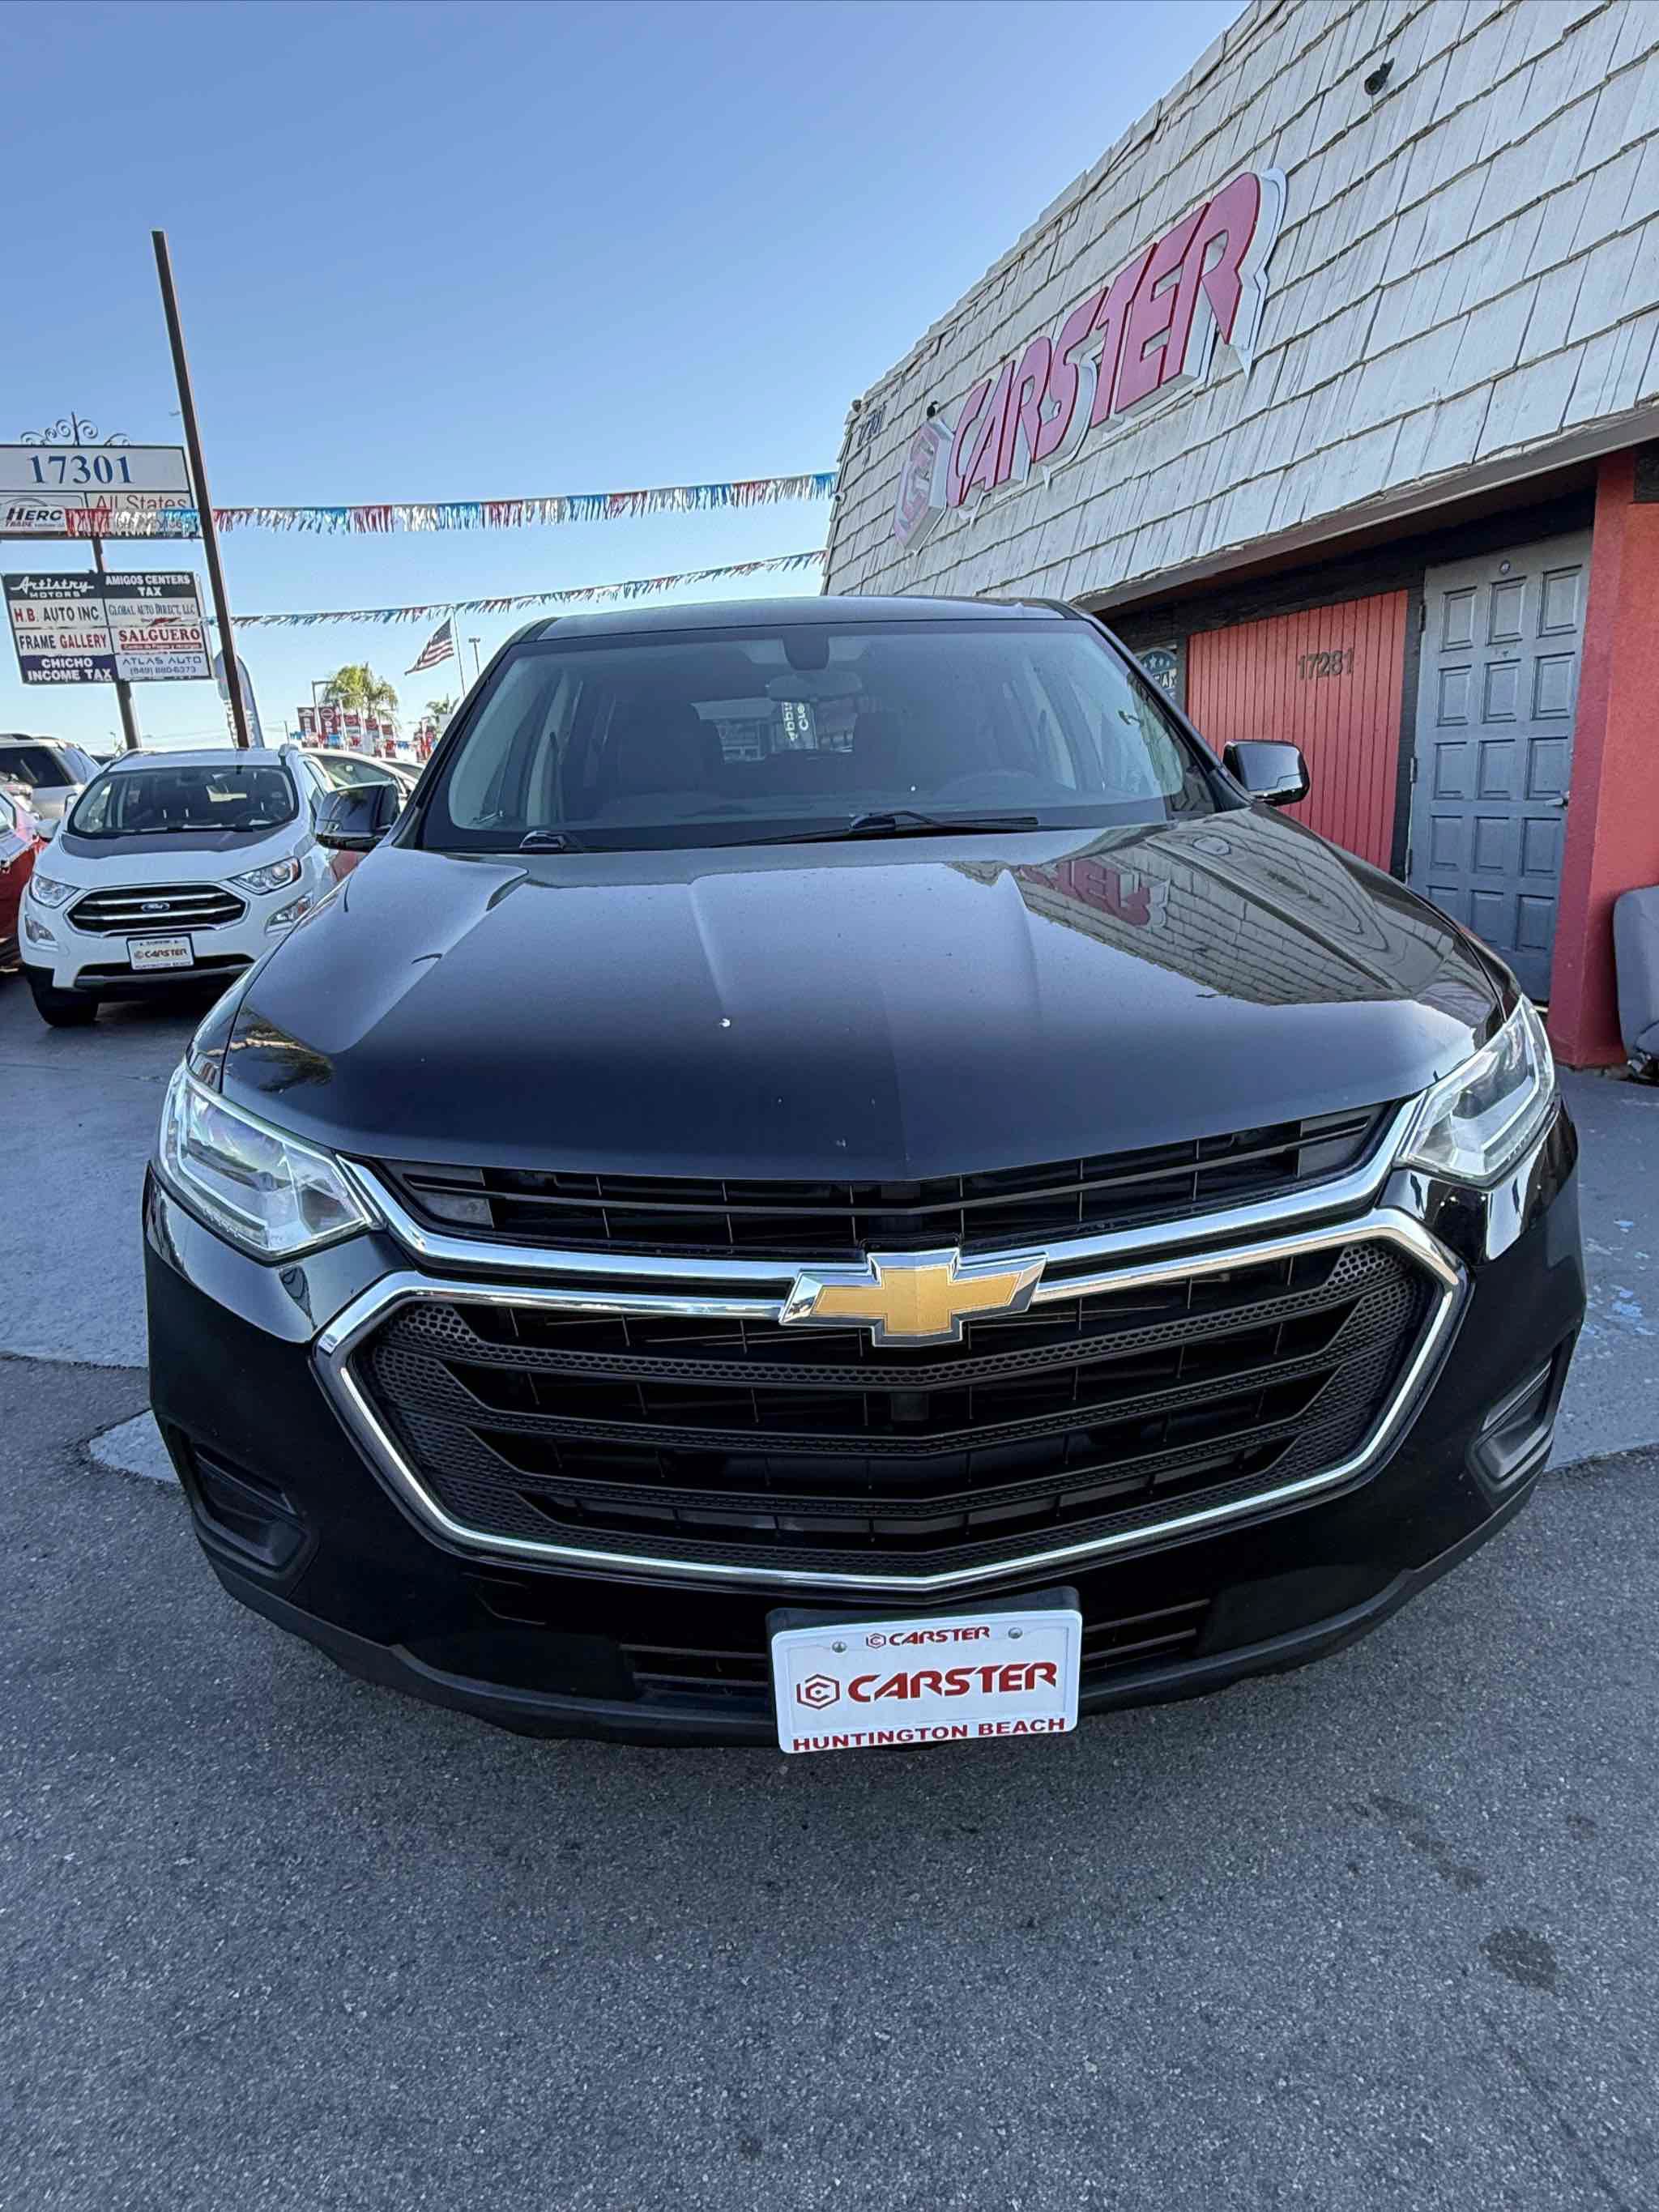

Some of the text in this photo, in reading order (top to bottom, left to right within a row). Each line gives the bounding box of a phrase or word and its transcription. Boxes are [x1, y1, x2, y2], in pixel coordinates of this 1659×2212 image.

[947, 171, 1261, 509] CARSTER
[28, 454, 135, 485] 17301
[97, 494, 187, 511] All States
[10, 576, 95, 595] Artistry
[105, 575, 190, 586] AMIGOS CENTERS
[137, 586, 163, 597] TAX
[43, 606, 75, 622] AUTO
[19, 635, 57, 650] FRAME
[60, 633, 107, 649] GALLERY
[119, 629, 201, 642] SALGUERO
[41, 658, 93, 668] CHICHO
[122, 655, 202, 666] ATLAS AUTO
[1299, 648, 1354, 680] 17281
[27, 668, 112, 681] INCOME TAX
[144, 948, 189, 959] CARSTER
[889, 1626, 991, 1647] CARSTER
[847, 1661, 1057, 1703] CARSTER
[793, 1717, 1065, 1752] HUNTINGTON BEACH
